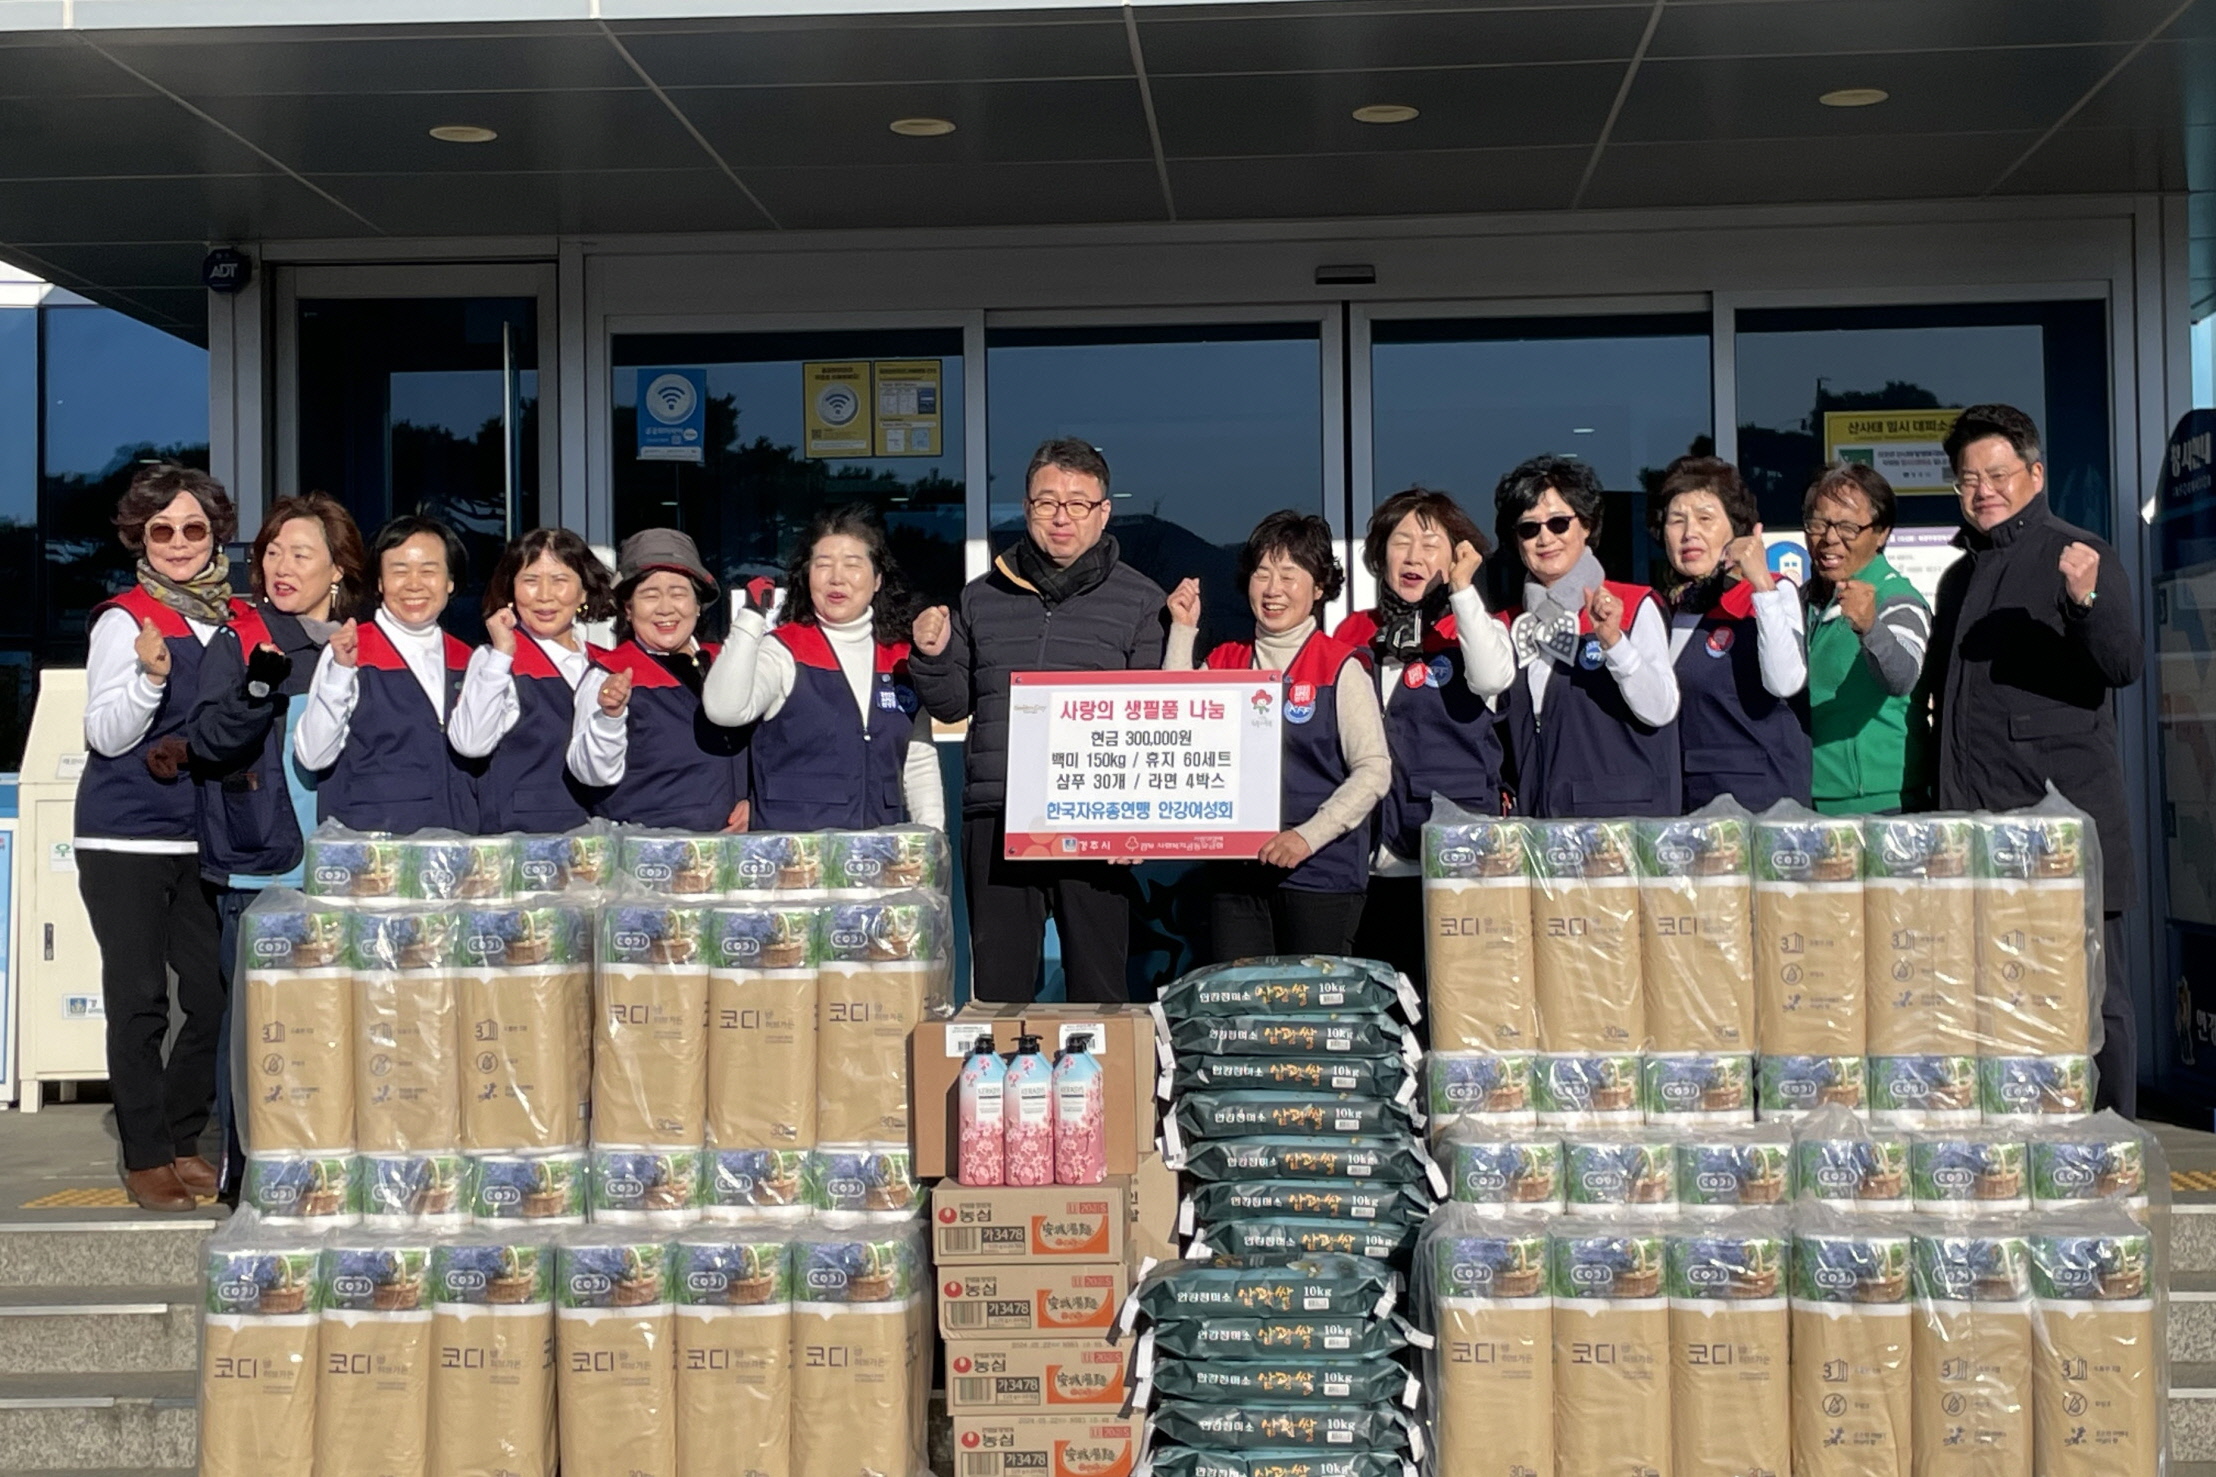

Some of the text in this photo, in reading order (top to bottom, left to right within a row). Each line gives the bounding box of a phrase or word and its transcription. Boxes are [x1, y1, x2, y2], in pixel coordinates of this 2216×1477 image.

[209, 263, 238, 278] ADT
[1848, 419, 1948, 434] 산사태 임시 대피소
[1060, 700, 1114, 721] 사랑의
[1124, 700, 1179, 720] 생필품
[1190, 700, 1226, 720] 나눔
[1090, 730, 1192, 747] 현금 300,000원
[1052, 750, 1232, 769] 백미 150kg / 휴지 60세트
[1094, 773, 1126, 790] 30개
[1133, 773, 1140, 790] /
[1148, 772, 1178, 790] 라면
[1186, 773, 1226, 790] 4박스
[1158, 800, 1233, 820] 안강여성회
[1440, 918, 1479, 936] 코디
[1548, 918, 1586, 936] 코디
[1657, 917, 1697, 936] 코디
[1200, 990, 1250, 1003] 안강정미소
[1319, 983, 1346, 994] 10kg
[610, 1004, 649, 1024] 코디
[720, 1009, 760, 1029] 코디
[830, 1002, 868, 1022] 코디
[1326, 1028, 1353, 1039] 10kg
[1332, 1066, 1359, 1077] 10kg
[1336, 1108, 1362, 1119] 10kg
[1348, 1154, 1376, 1164] 10kg
[1352, 1196, 1378, 1207] 10kg
[960, 1209, 992, 1223] 농심
[984, 1228, 1024, 1241] 가3478
[1365, 1236, 1392, 1246] 10kg
[965, 1282, 997, 1296] 농심
[1177, 1291, 1232, 1303] 안강정미소
[1304, 1286, 1332, 1298] 10kg
[989, 1302, 1030, 1315] 가3478
[1198, 1330, 1252, 1341] 안강정미소
[1324, 1325, 1352, 1336] 10kg
[442, 1348, 483, 1368] 코디
[687, 1350, 729, 1369] 코디
[806, 1347, 848, 1367] 코디
[1452, 1342, 1495, 1363] 코디
[1572, 1343, 1615, 1363] 코디
[1688, 1344, 1732, 1364] 코디
[214, 1358, 256, 1378] 코디
[328, 1353, 371, 1374] 코디
[572, 1352, 614, 1372] 코디
[974, 1358, 1006, 1373] 농심
[998, 1379, 1038, 1392] 가3478
[1196, 1372, 1251, 1386] 안강정미소
[1324, 1372, 1352, 1384] 10kg
[1327, 1418, 1356, 1431] 10kg
[982, 1433, 1014, 1448] 농심
[1006, 1454, 1046, 1466] 가3478
[1320, 1463, 1349, 1475] 10kg
